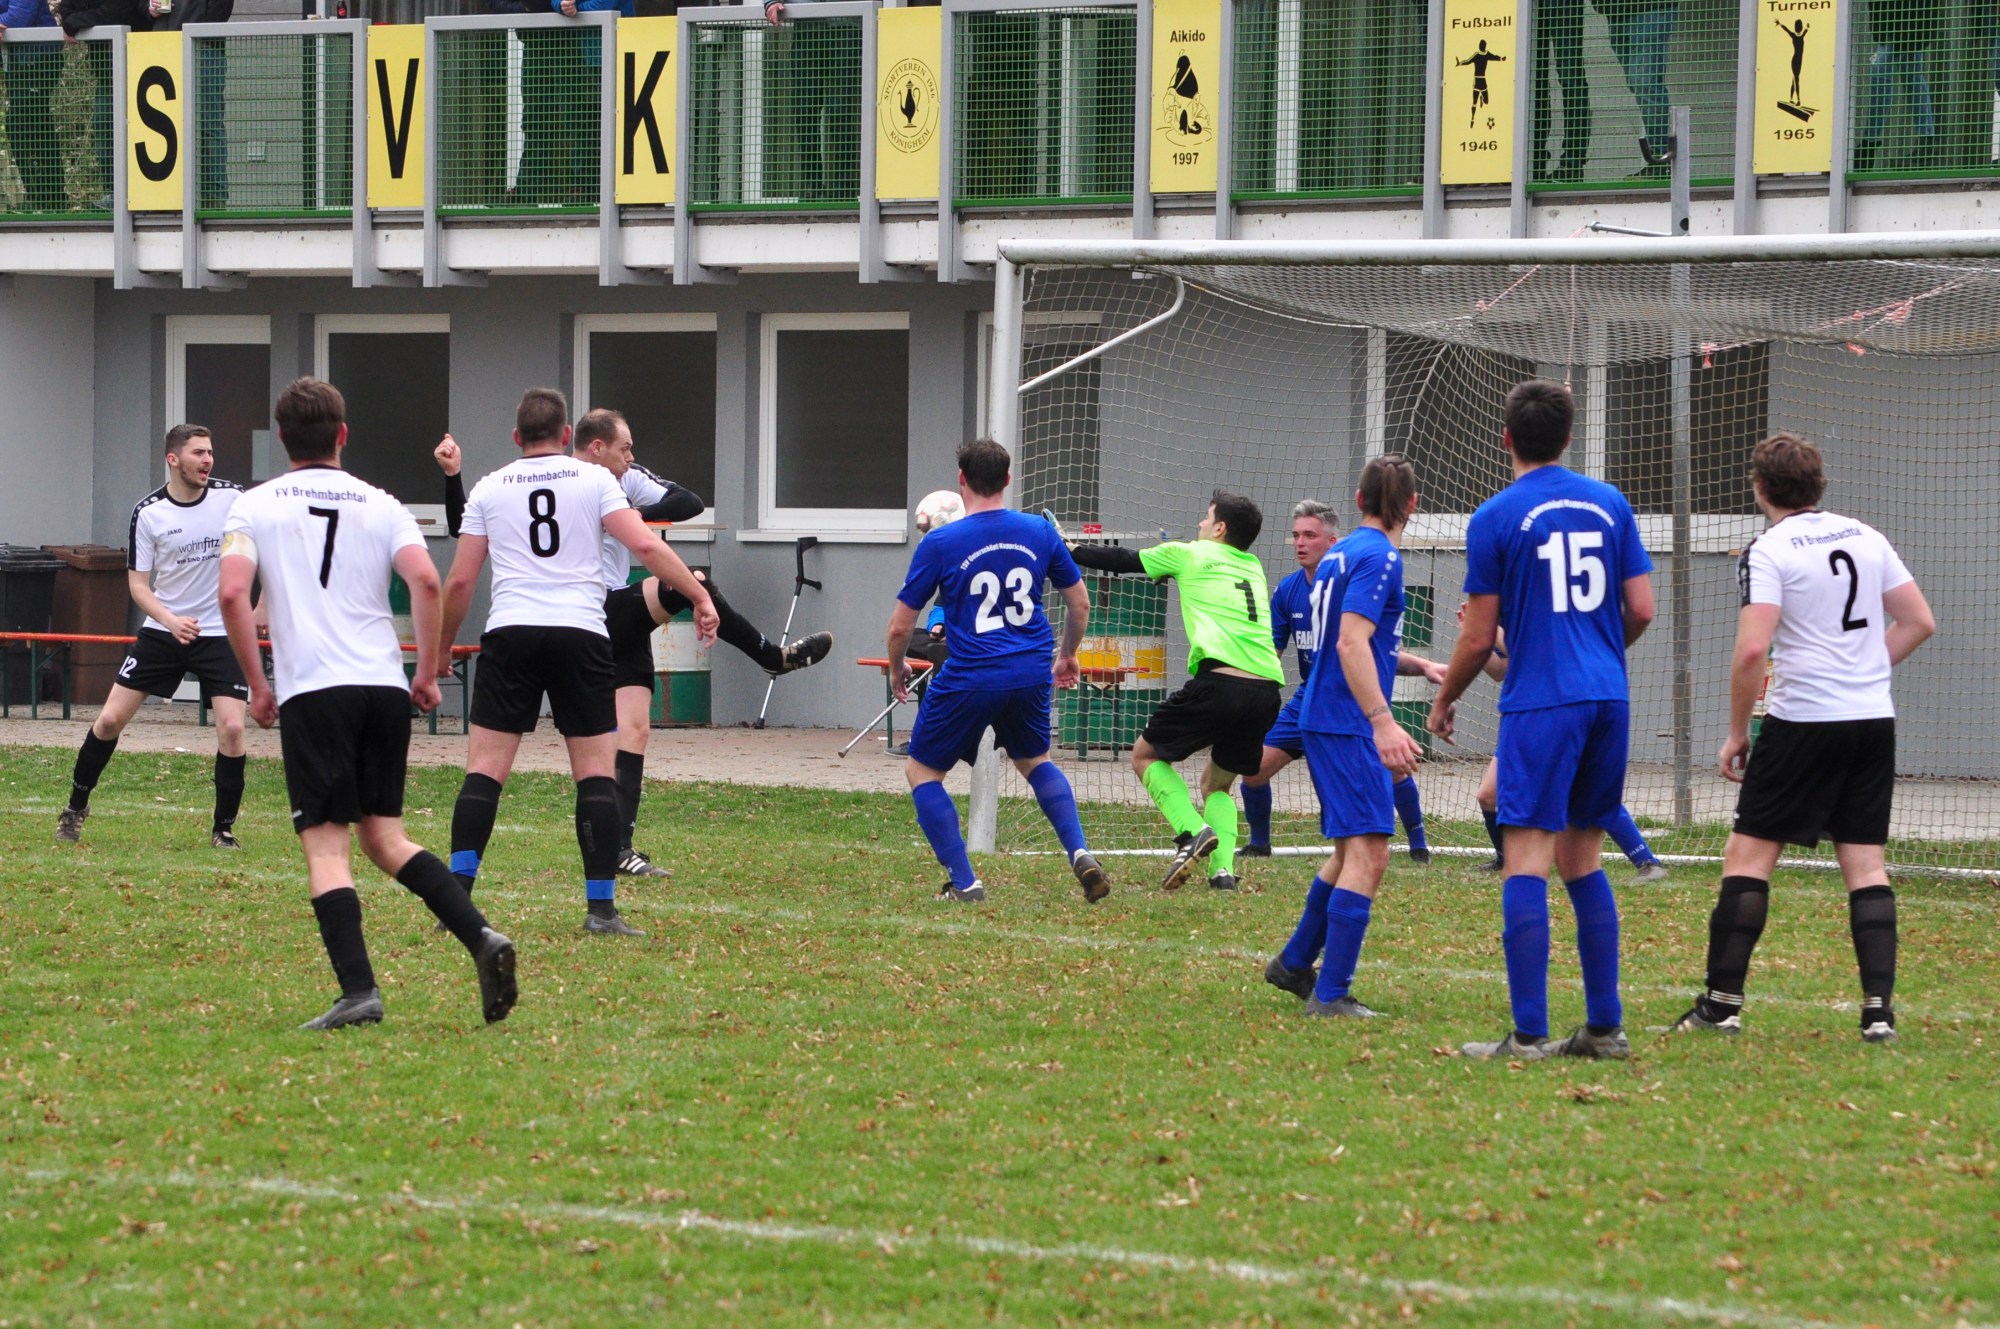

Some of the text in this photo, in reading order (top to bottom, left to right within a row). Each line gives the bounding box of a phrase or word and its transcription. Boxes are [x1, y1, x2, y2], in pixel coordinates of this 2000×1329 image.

[1767, 0, 1831, 12] Turnen
[1452, 16, 1512, 29] Fußball
[1169, 29, 1206, 43] Aikido
[884, 63, 936, 101] SPORTVEREIN 1946
[134, 65, 178, 182] S
[374, 57, 420, 179] V
[623, 50, 671, 175] K
[889, 128, 931, 150] KÖNIGHEIM
[1459, 140, 1498, 152] 1946
[1773, 128, 1815, 141] 1965
[1172, 152, 1199, 165] 1997
[503, 469, 579, 484] FV Brehmbachtal
[275, 486, 367, 503] FV Brehmbachtal
[167, 528, 183, 536] JAKO
[528, 488, 560, 558] 8
[178, 536, 220, 554] wohnfitz
[308, 505, 339, 590] 7
[1790, 537, 1804, 549] FV
[1537, 531, 1606, 613] 15
[969, 567, 1035, 634] 23
[1234, 579, 1258, 623] 1
[1828, 549, 1869, 632] 2
[1309, 577, 1334, 652] 11
[118, 655, 138, 679] 12
